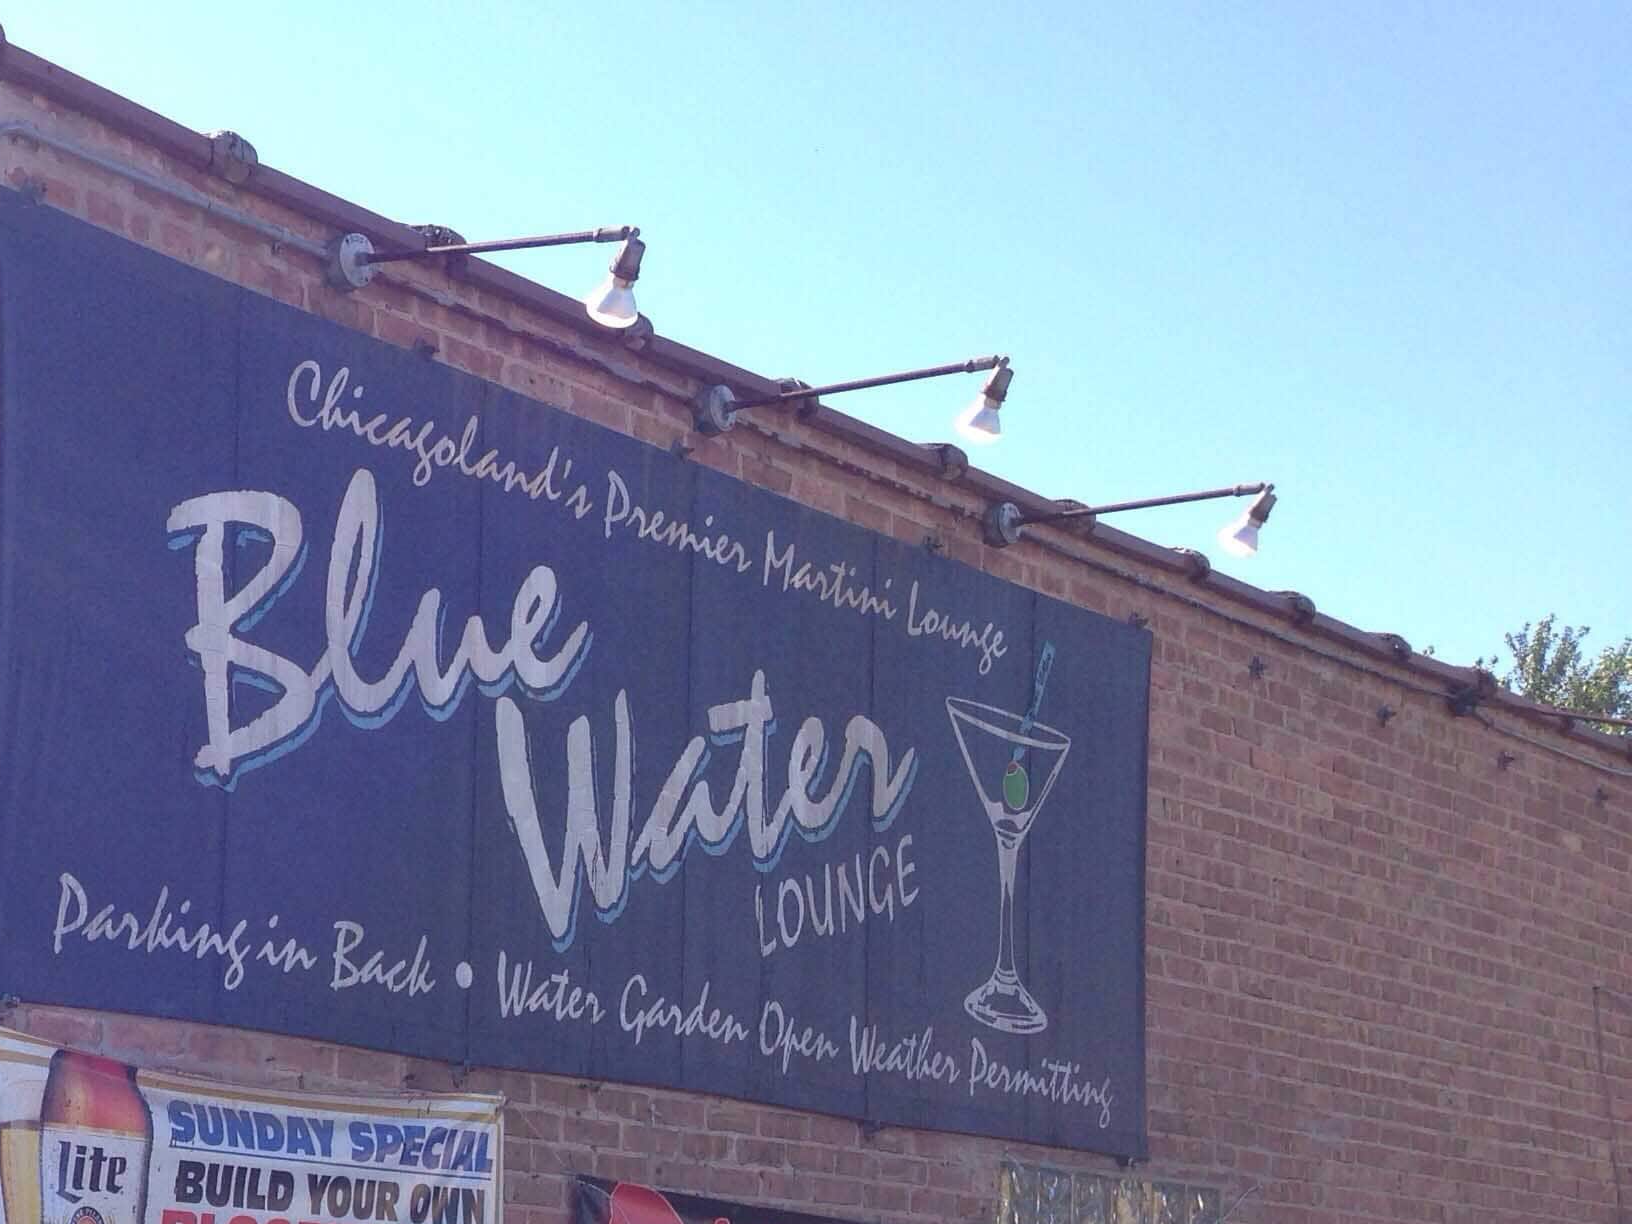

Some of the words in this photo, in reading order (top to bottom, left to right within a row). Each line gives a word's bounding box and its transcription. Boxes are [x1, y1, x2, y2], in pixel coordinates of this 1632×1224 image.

[287, 360, 591, 517] Chicagoland's
[604, 470, 752, 571] Premier
[764, 532, 897, 621] Martini
[907, 581, 1007, 675] Lounge
[167, 469, 590, 785] Blue
[495, 668, 917, 948] Water
[755, 833, 919, 957] LOUNGE
[54, 872, 250, 990] Parking
[252, 915, 317, 970] in
[330, 921, 436, 994] Back
[497, 951, 607, 1023] Water
[620, 974, 749, 1044] Garden
[759, 1001, 839, 1074] Open
[850, 1015, 960, 1084] Weather
[968, 1038, 1115, 1128] Permitting
[56, 1140, 126, 1202] Lite
[168, 1100, 334, 1157] SUNDAY
[352, 1121, 492, 1173] SPECIAL
[175, 1160, 294, 1212] BUILD
[307, 1175, 401, 1223] YOUR
